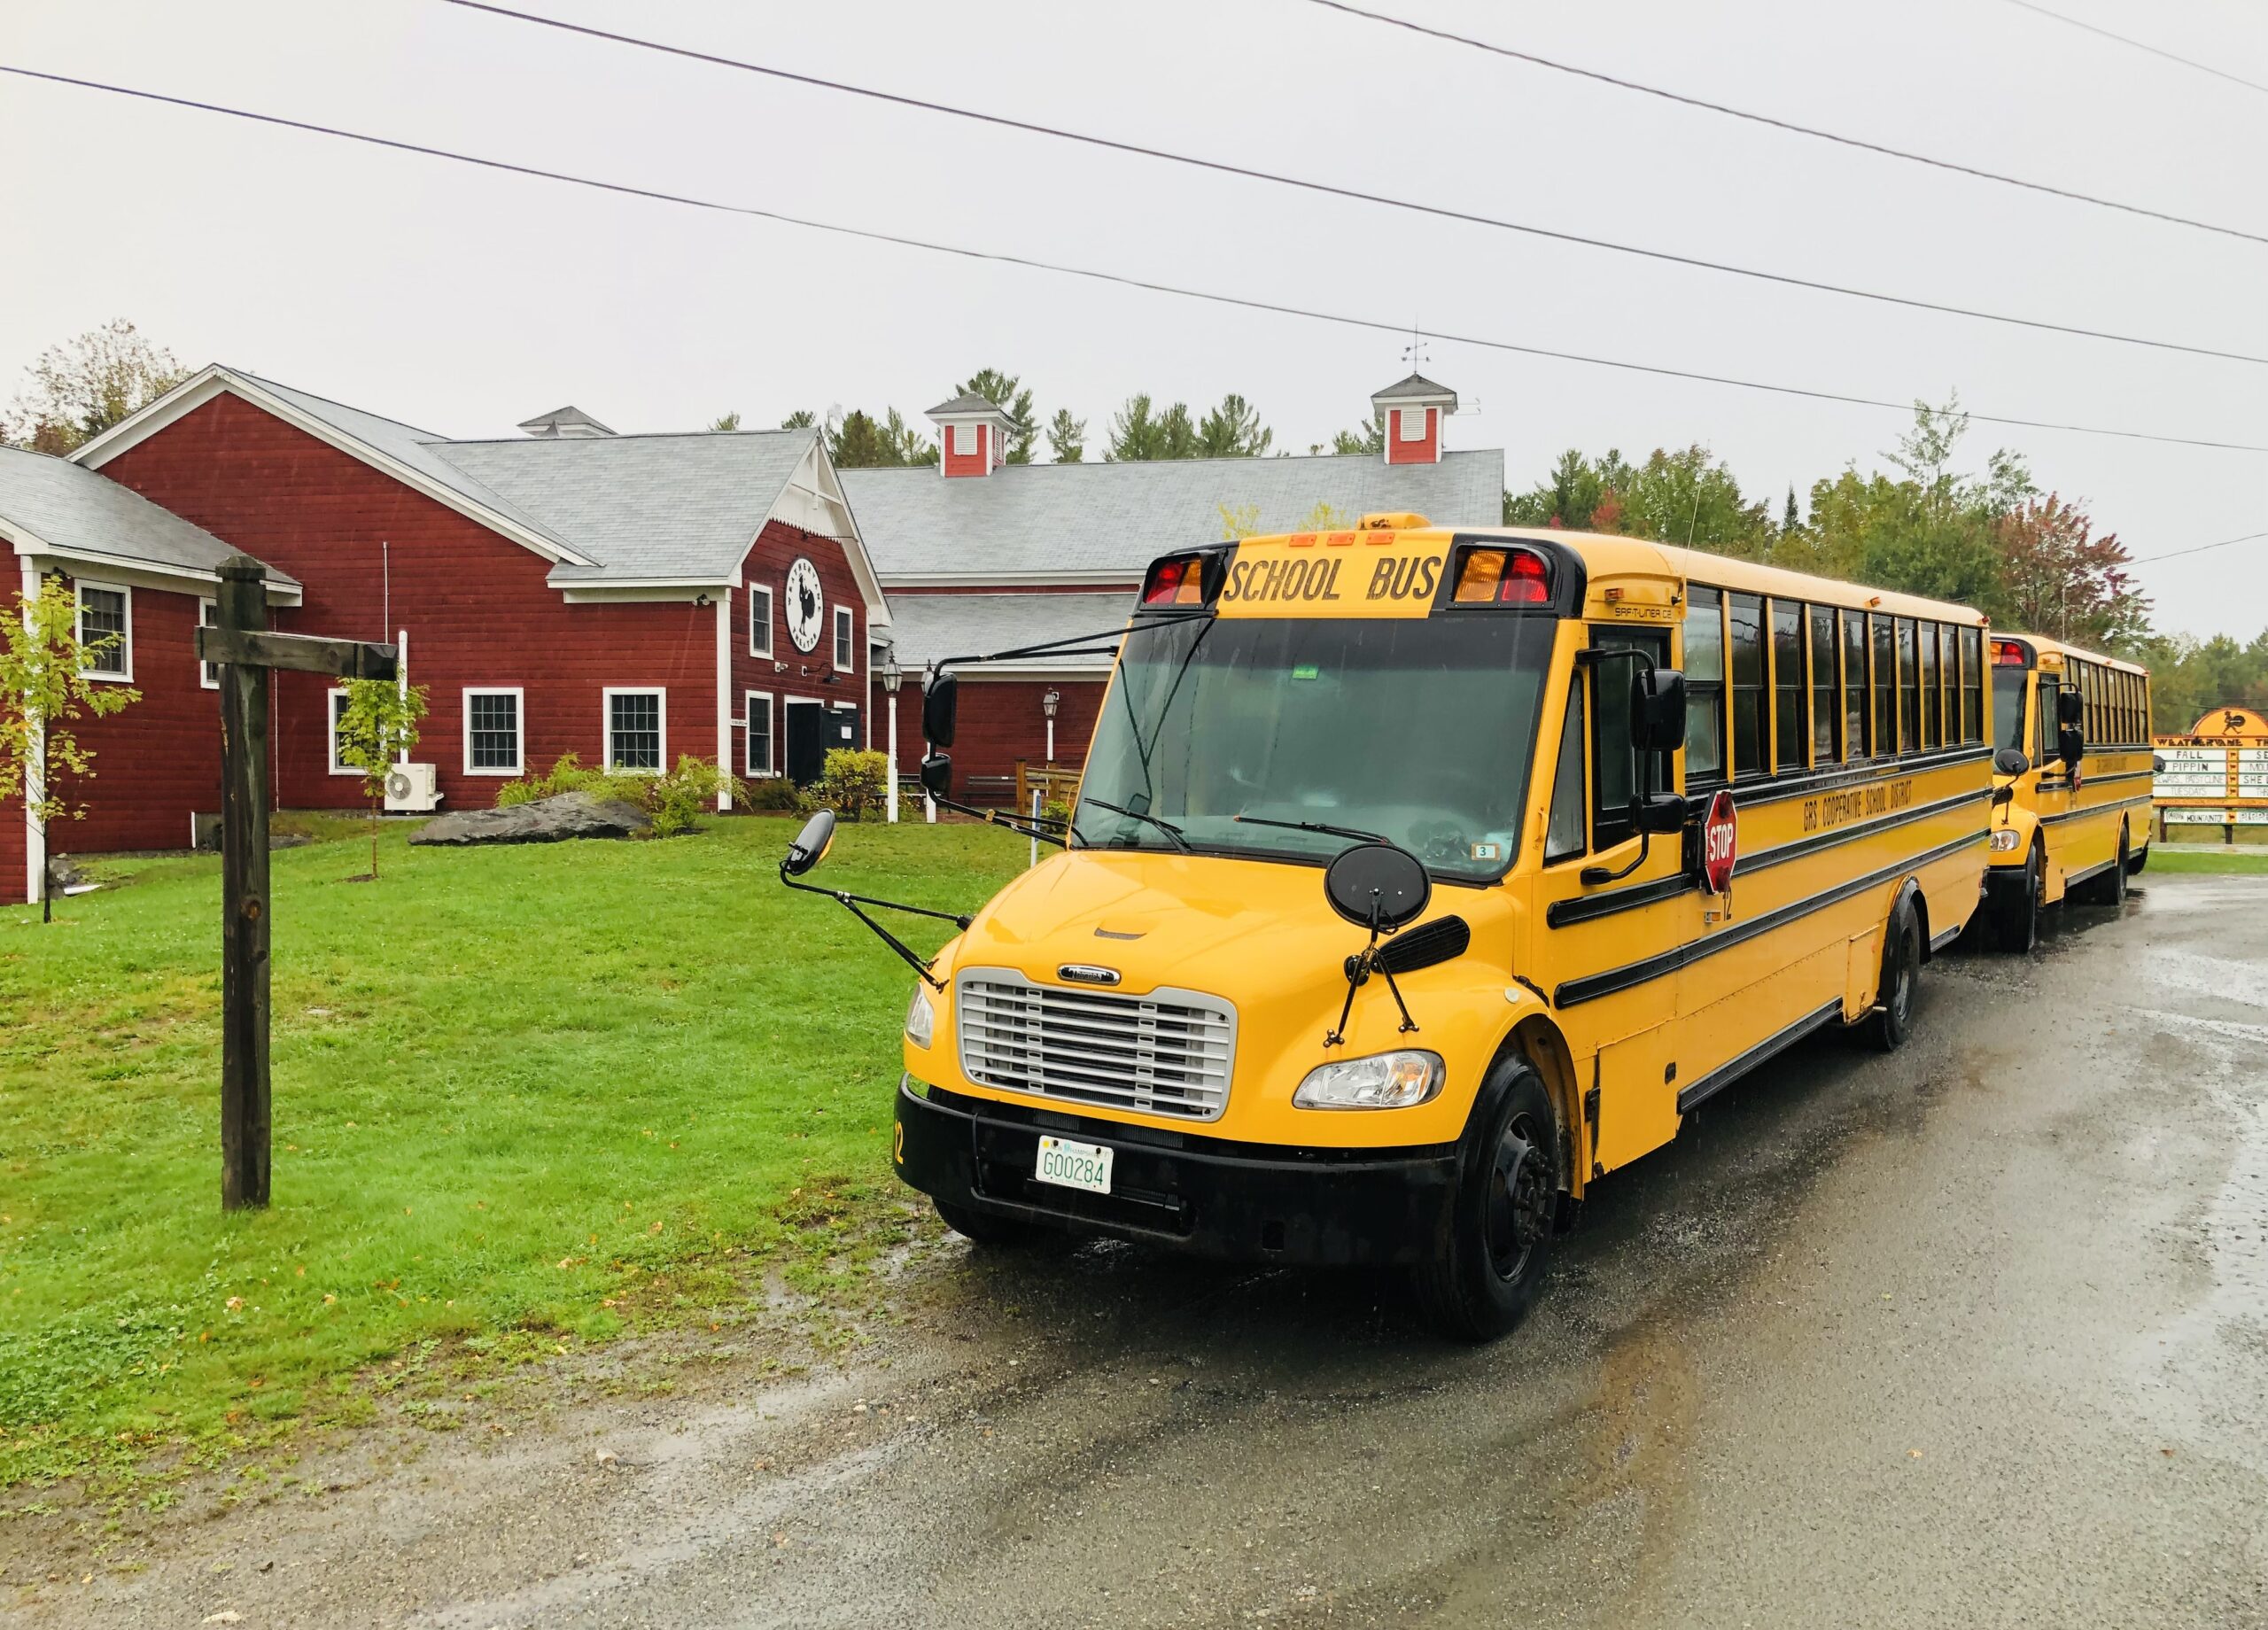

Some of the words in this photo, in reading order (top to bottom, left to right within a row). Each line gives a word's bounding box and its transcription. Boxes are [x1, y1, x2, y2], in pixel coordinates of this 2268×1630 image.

[1223, 558, 1342, 602] SCHOOL
[1365, 555, 1442, 601] BUS
[2176, 750, 2203, 759] FALL
[2172, 763, 2209, 772] PIPPIN
[2243, 775, 2262, 784] SHE
[1822, 790, 1861, 827] COOPERATIVE
[1866, 786, 1886, 816] SCHOOL
[1891, 780, 1912, 809] DISTRICT
[1710, 822, 1734, 862] STOP
[1480, 846, 1487, 857] 3
